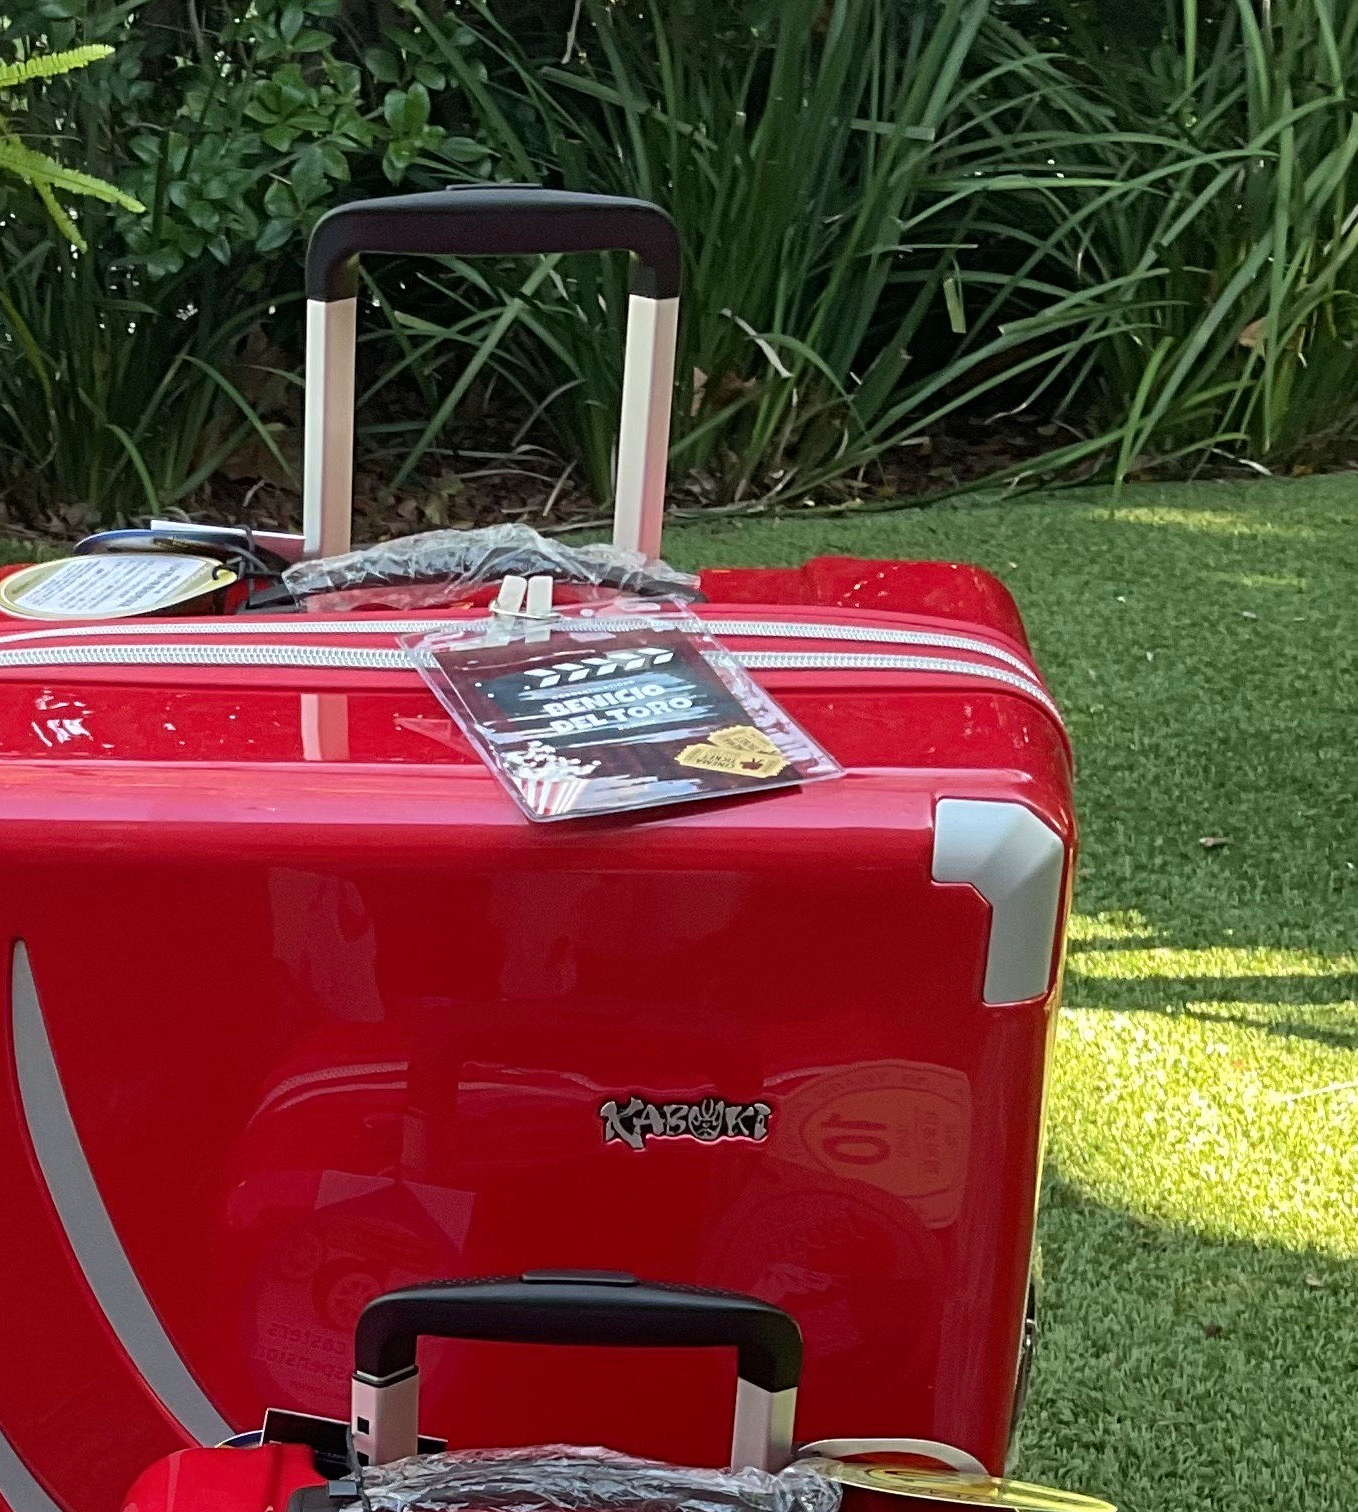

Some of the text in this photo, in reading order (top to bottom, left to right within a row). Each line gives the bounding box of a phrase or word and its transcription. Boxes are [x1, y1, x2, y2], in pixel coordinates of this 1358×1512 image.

[542, 684, 666, 717] BENICIO
[549, 713, 609, 735] DEL
[605, 697, 693, 722] TORO
